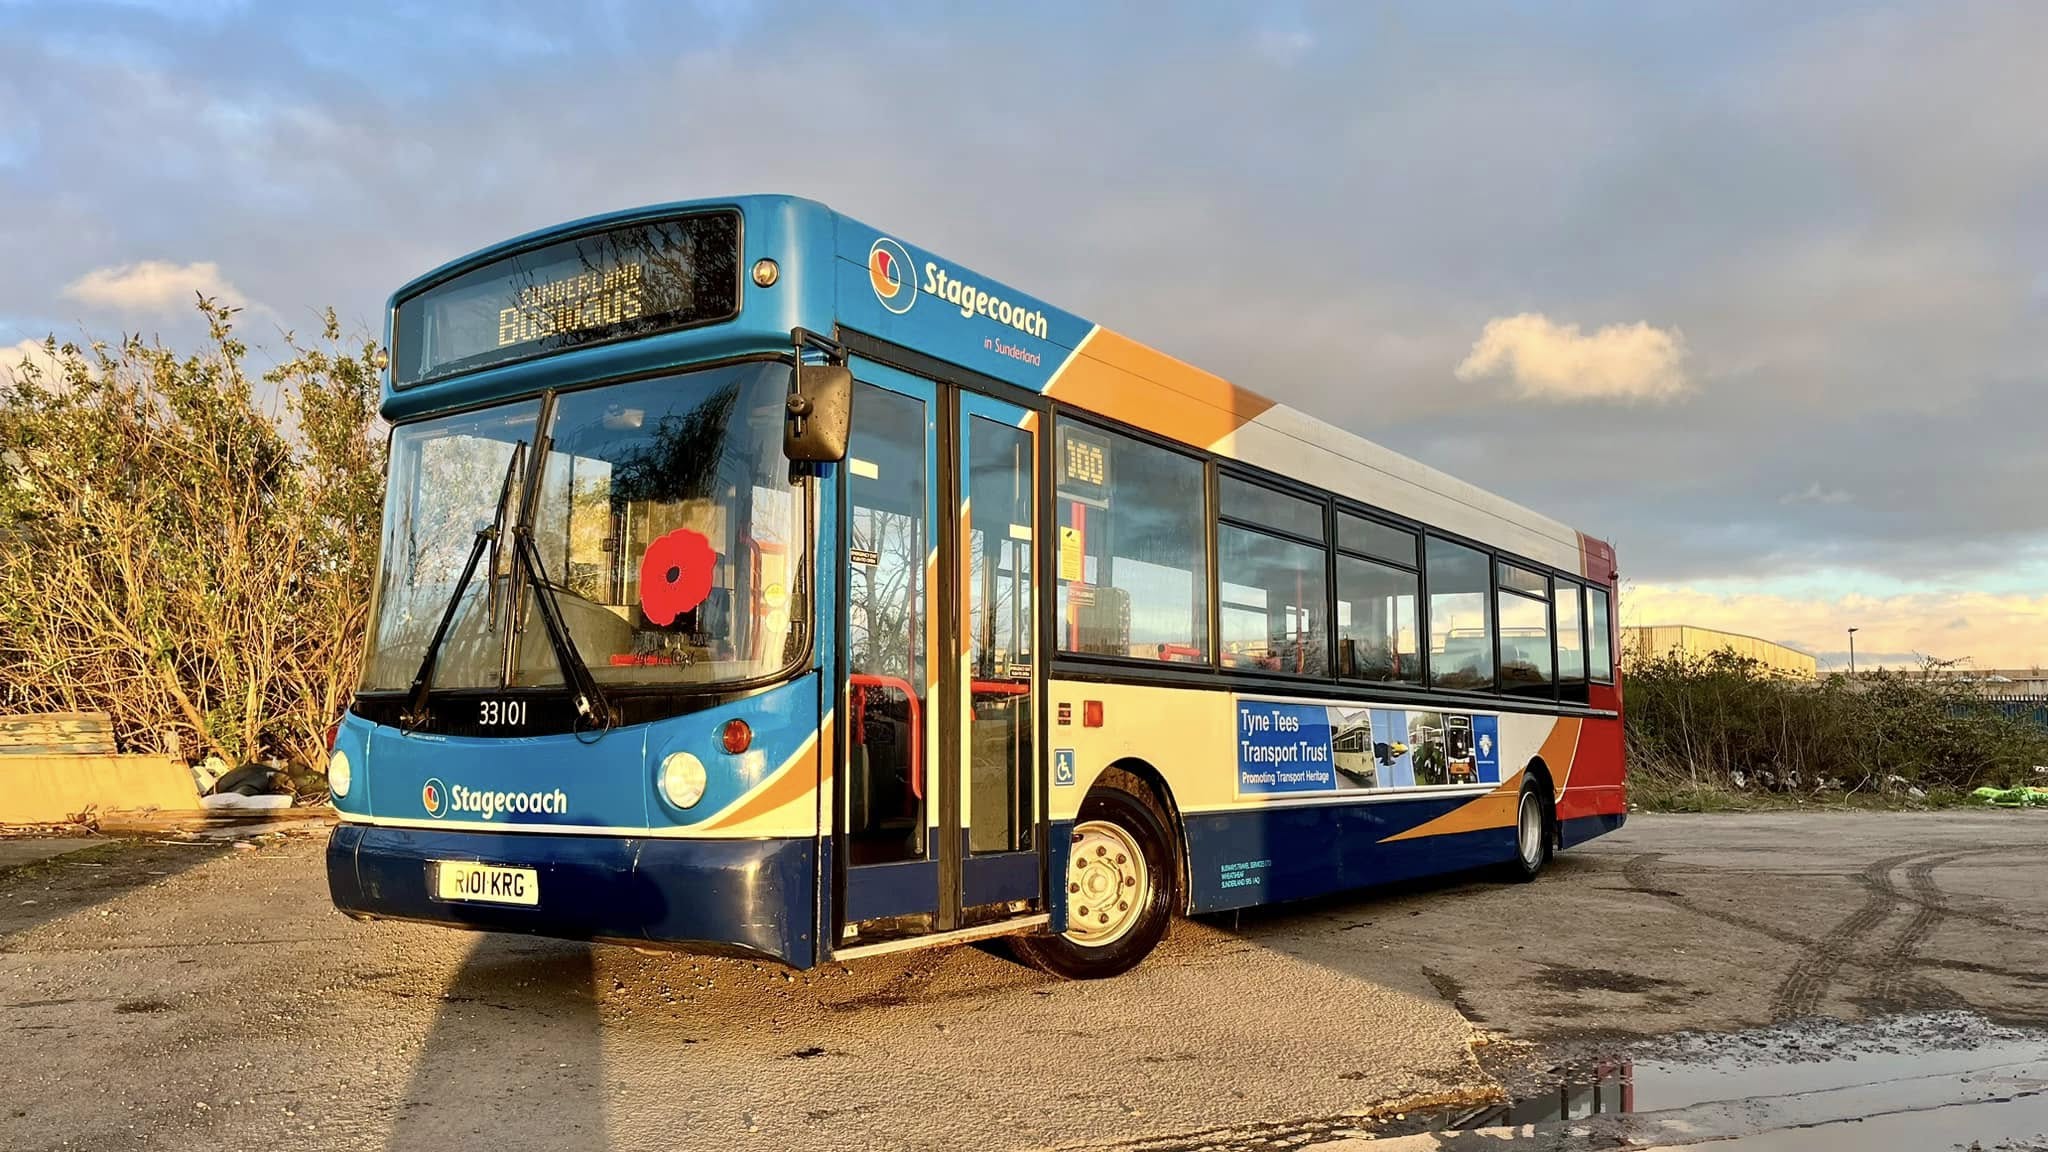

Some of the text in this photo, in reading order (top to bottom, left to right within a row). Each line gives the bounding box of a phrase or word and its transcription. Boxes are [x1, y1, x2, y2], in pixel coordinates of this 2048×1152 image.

[521, 262, 640, 309] SUNDERLAND
[923, 262, 1048, 340] Stagecoach
[983, 335, 1041, 367] in Sunderland
[1067, 439, 1103, 485] 100
[479, 701, 526, 726] 33101
[1241, 709, 1299, 737] Tyne Tees
[1241, 740, 1327, 767] Transport Trust
[1242, 769, 1329, 786] Promoting Transport Heritage
[451, 784, 568, 820] Stagecoach
[456, 870, 525, 897] R101 KRG
